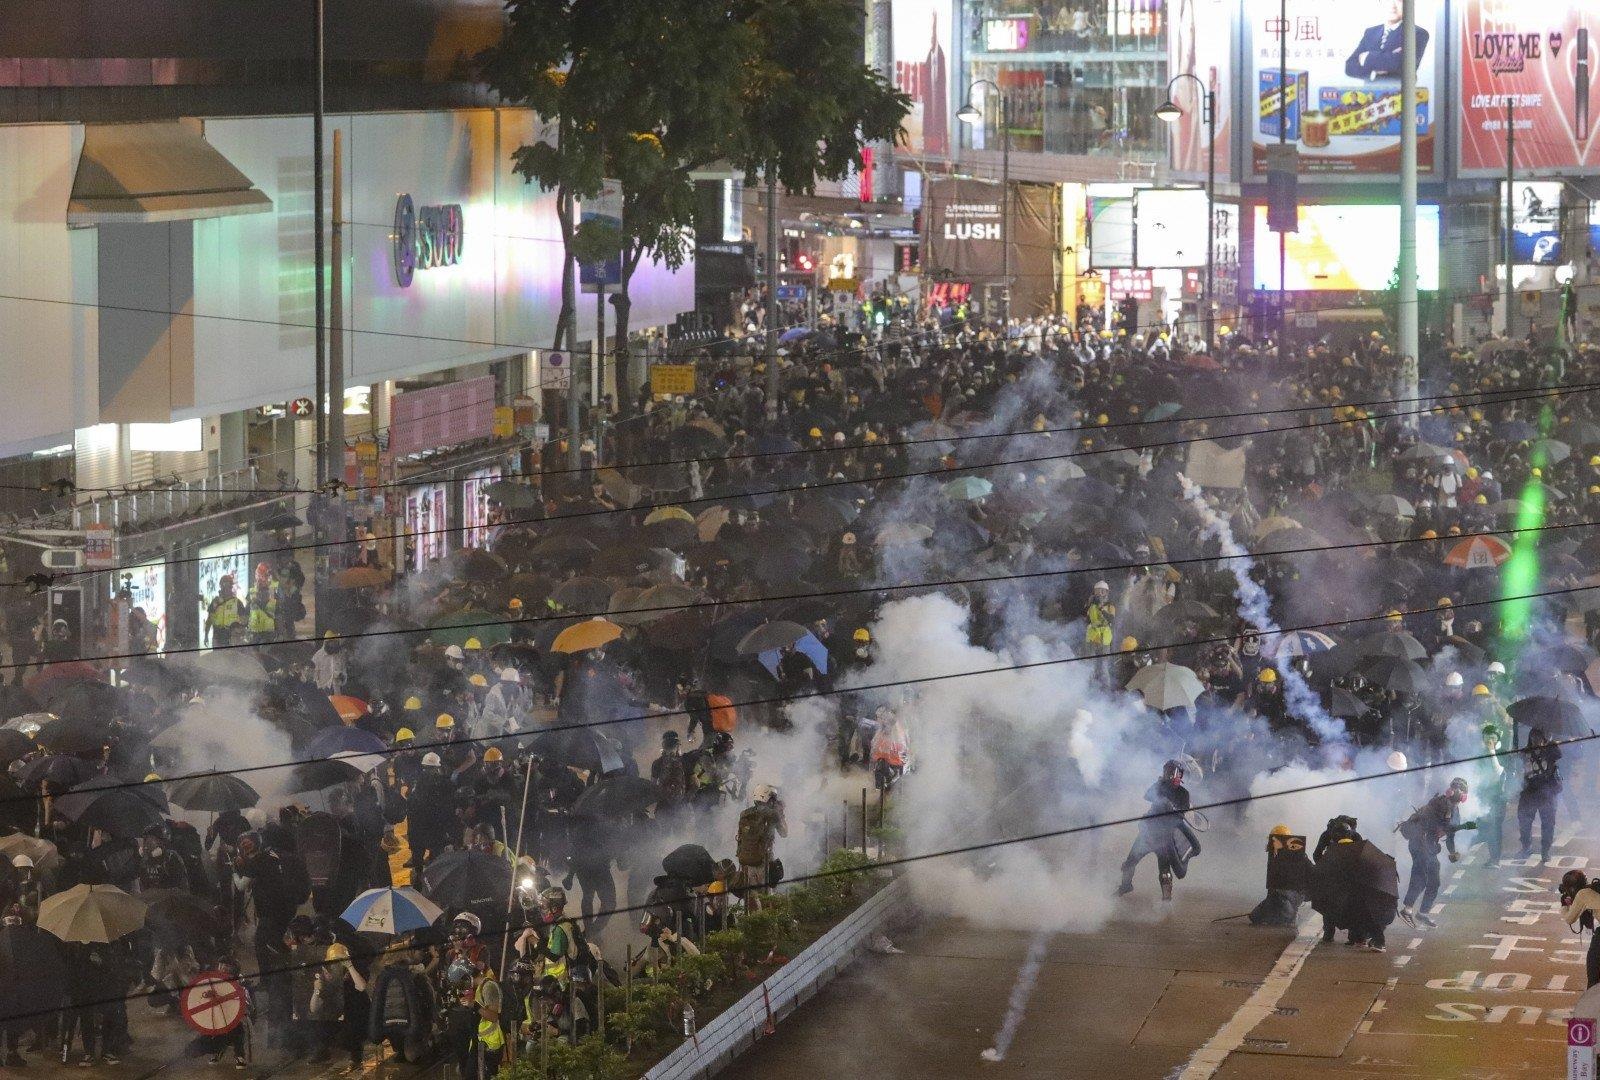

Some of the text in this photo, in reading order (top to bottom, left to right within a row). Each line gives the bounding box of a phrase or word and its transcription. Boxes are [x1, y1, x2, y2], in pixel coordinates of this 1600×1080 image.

[1265, 15, 1322, 41] 中風
[1474, 33, 1541, 59] LOVE ME
[1471, 94, 1491, 108] LOVE
[1490, 94, 1501, 108] AT
[1500, 94, 1521, 108] FIST
[944, 222, 1001, 240] LUSH
[1424, 970, 1580, 996] TOP
